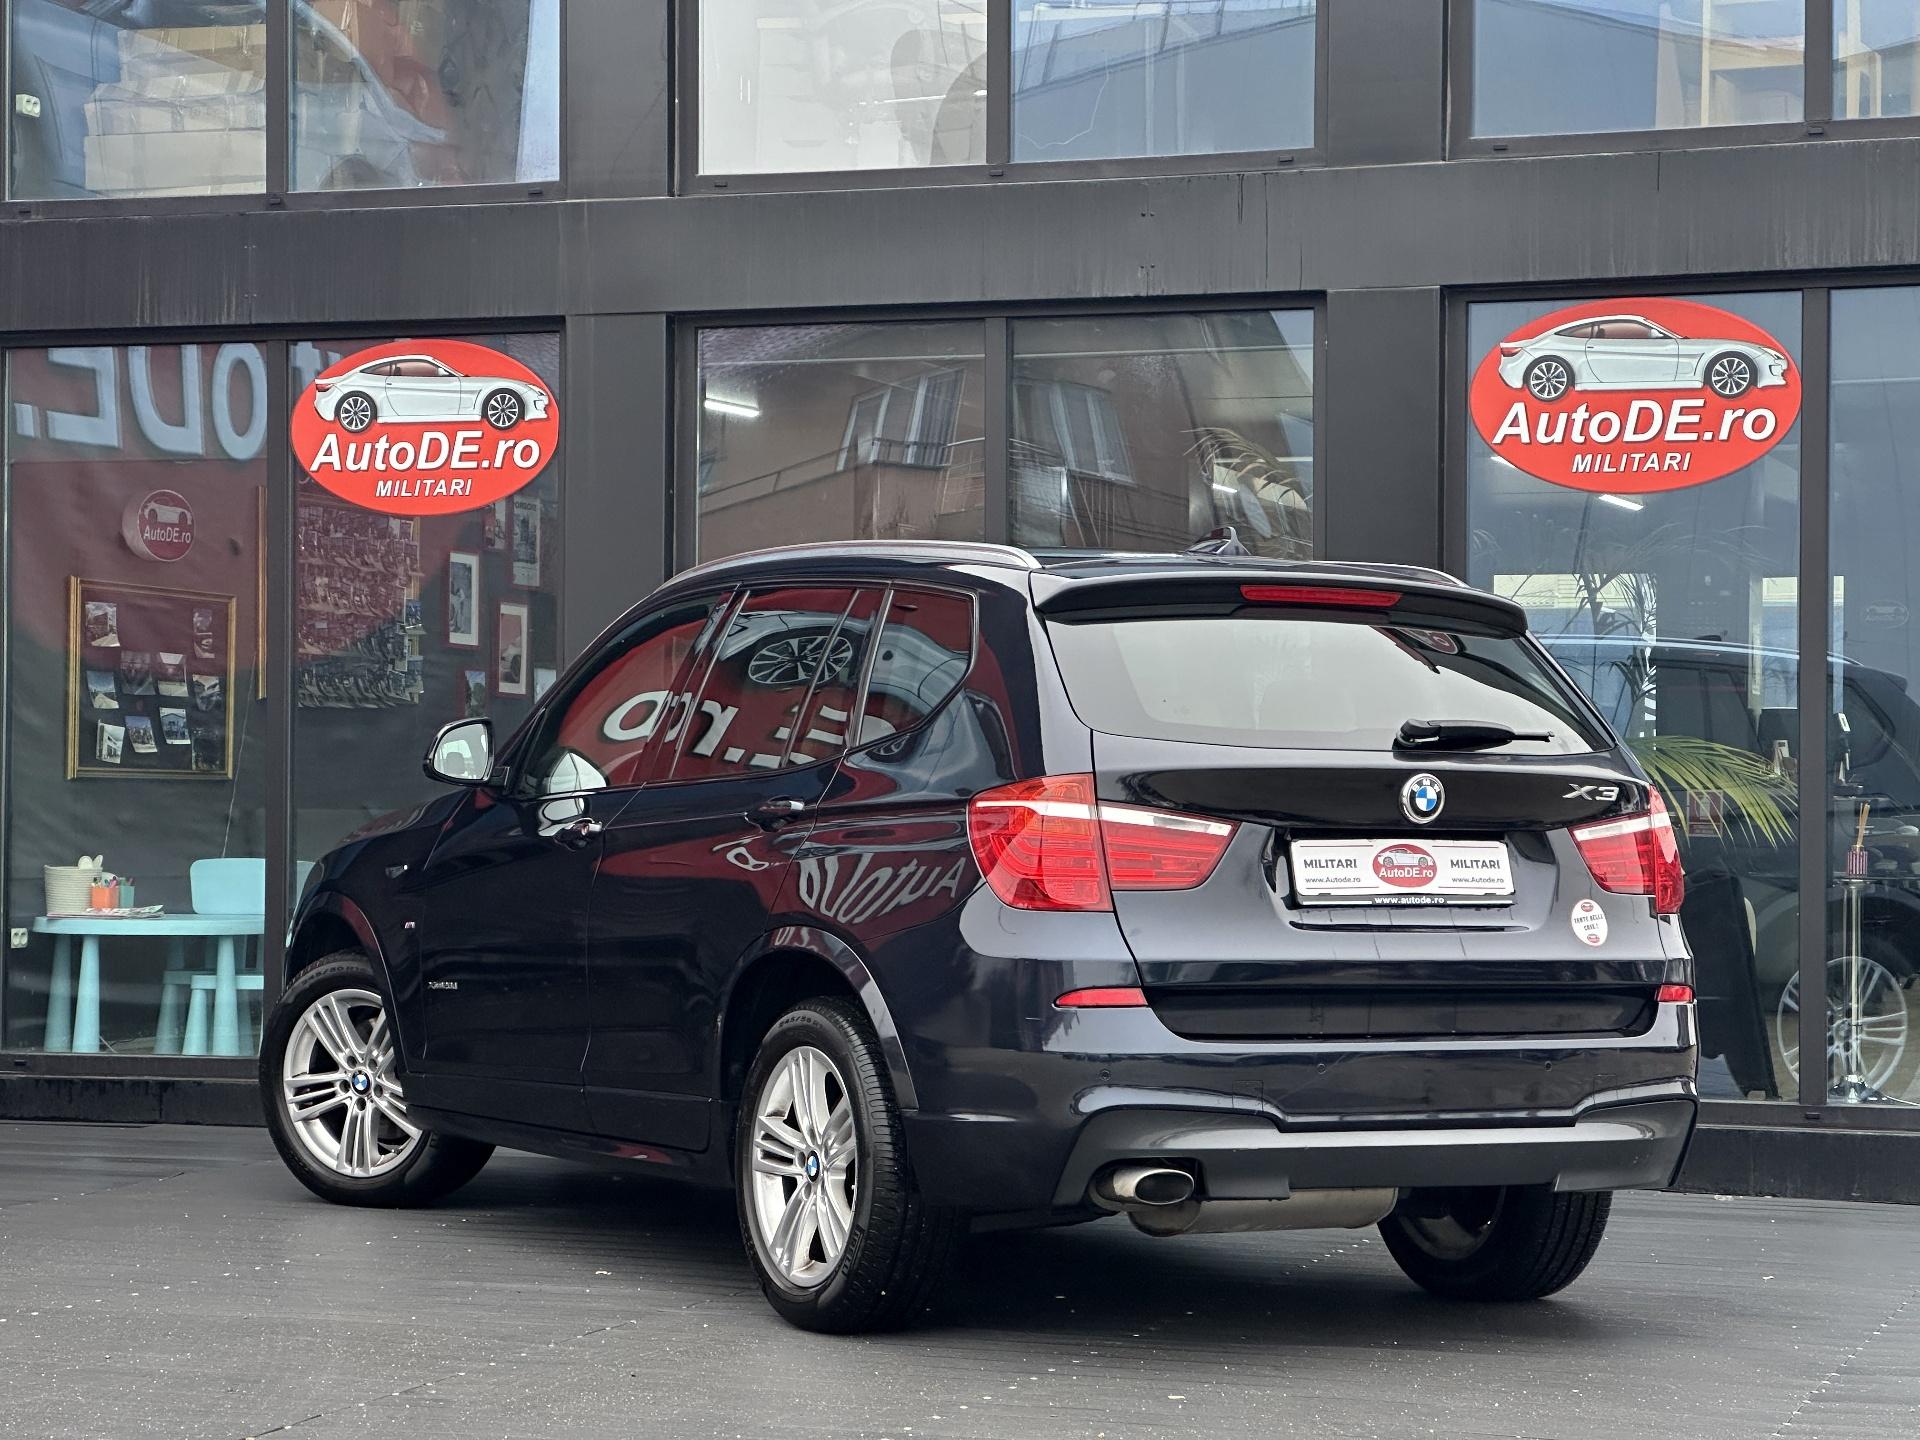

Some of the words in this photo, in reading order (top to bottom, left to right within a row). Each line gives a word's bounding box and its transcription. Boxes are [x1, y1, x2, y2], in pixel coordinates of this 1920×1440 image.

[1492, 398, 1777, 445] AutoDE.ro
[309, 430, 541, 473] AutoDE.ro
[1571, 452, 1692, 474] MILITARI
[375, 479, 473, 498] MILITARI
[143, 526, 192, 544] AutoDE.ro
[1411, 778, 1441, 793] BMW
[1562, 783, 1620, 801] X3
[1303, 859, 1358, 869] MILITARI
[1450, 859, 1501, 869] MILITARI
[1378, 867, 1434, 878] AutoDE.ro
[1451, 876, 1505, 884] www.Autode.ro
[1374, 896, 1445, 905] www.autode.ro
